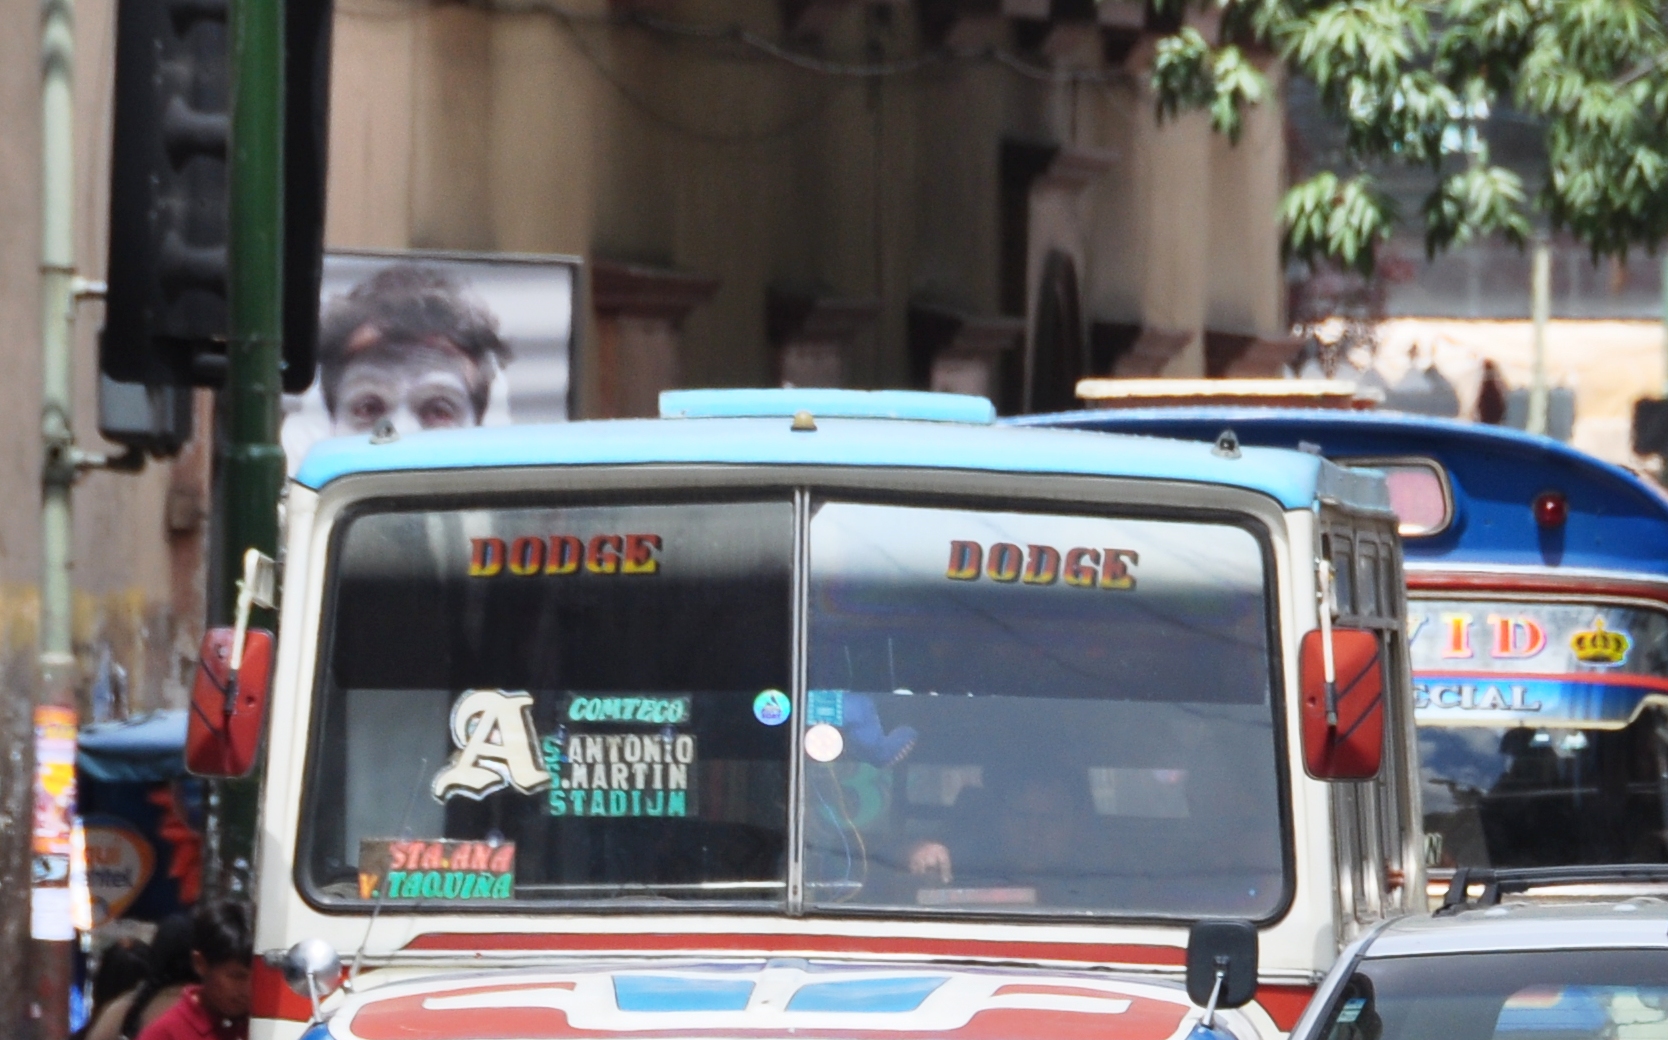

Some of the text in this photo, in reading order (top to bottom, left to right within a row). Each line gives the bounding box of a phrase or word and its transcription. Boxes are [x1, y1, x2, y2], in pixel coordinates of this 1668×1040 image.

[468, 533, 662, 577] DODGE
[946, 540, 1139, 590] DODGE
[431, 688, 551, 806] A
